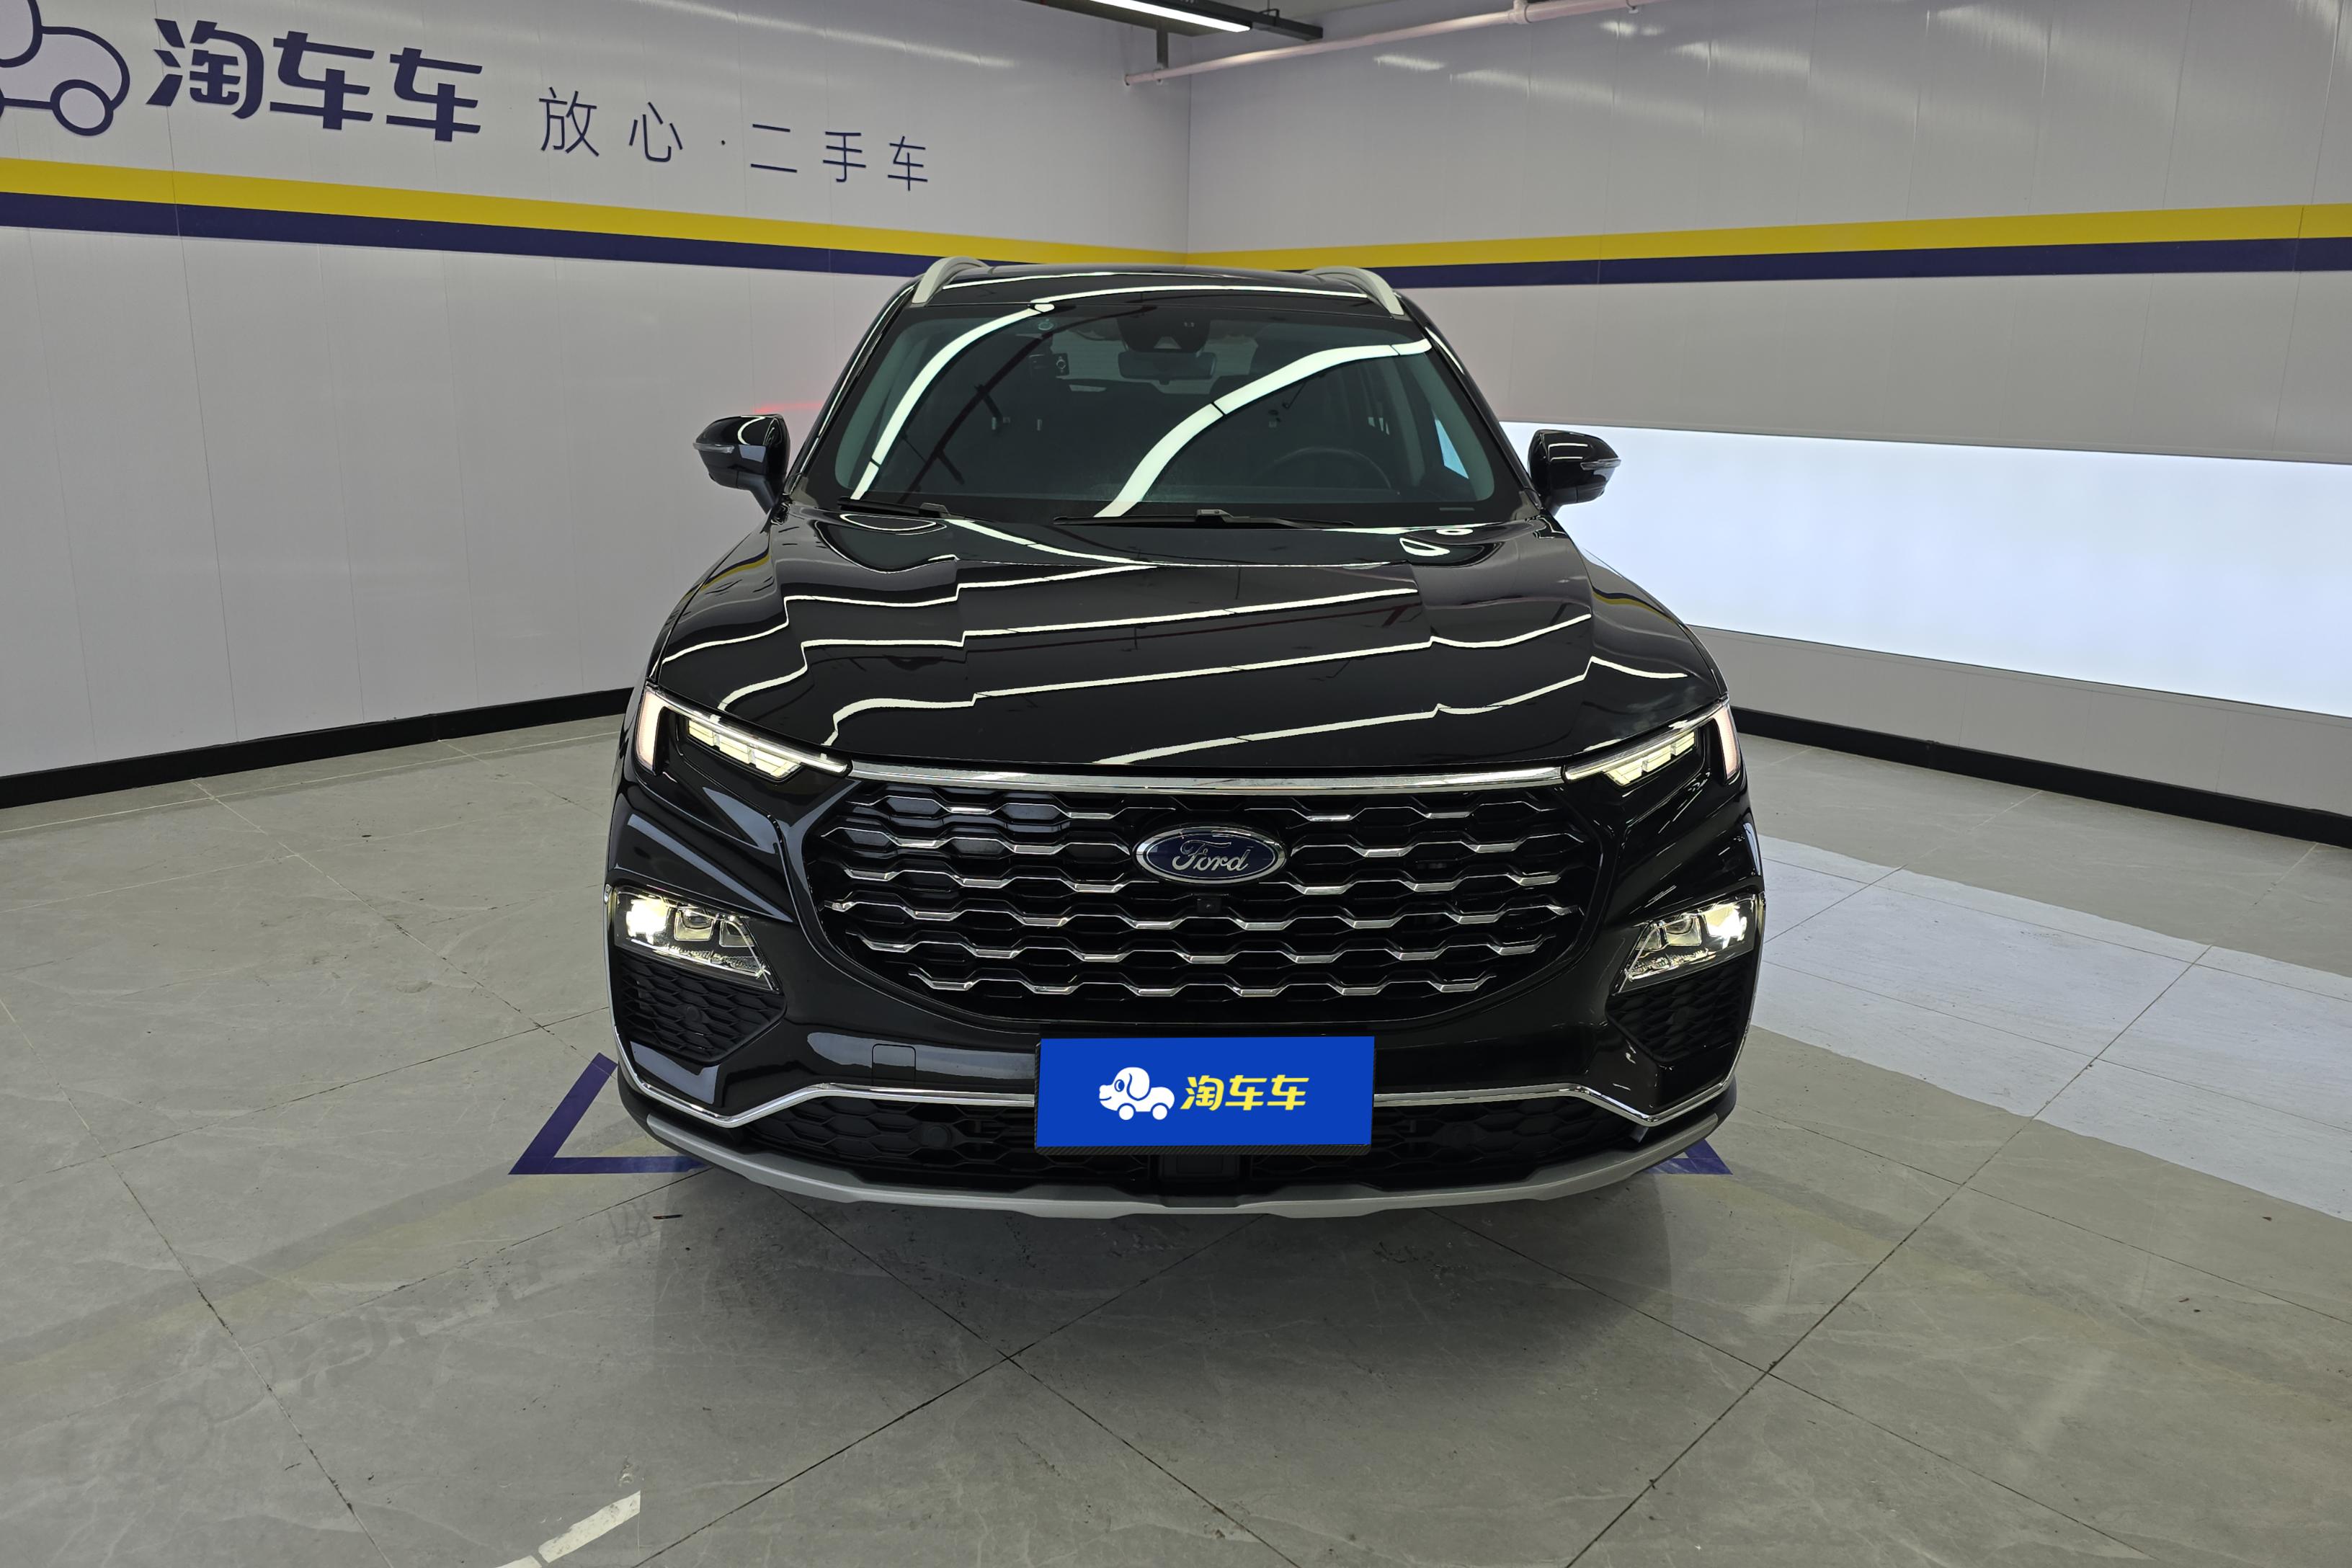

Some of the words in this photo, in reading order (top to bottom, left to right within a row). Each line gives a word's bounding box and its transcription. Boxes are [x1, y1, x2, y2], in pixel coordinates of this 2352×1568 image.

[146, 18, 483, 142] 淘车车
[1172, 839, 1251, 871] Ford
